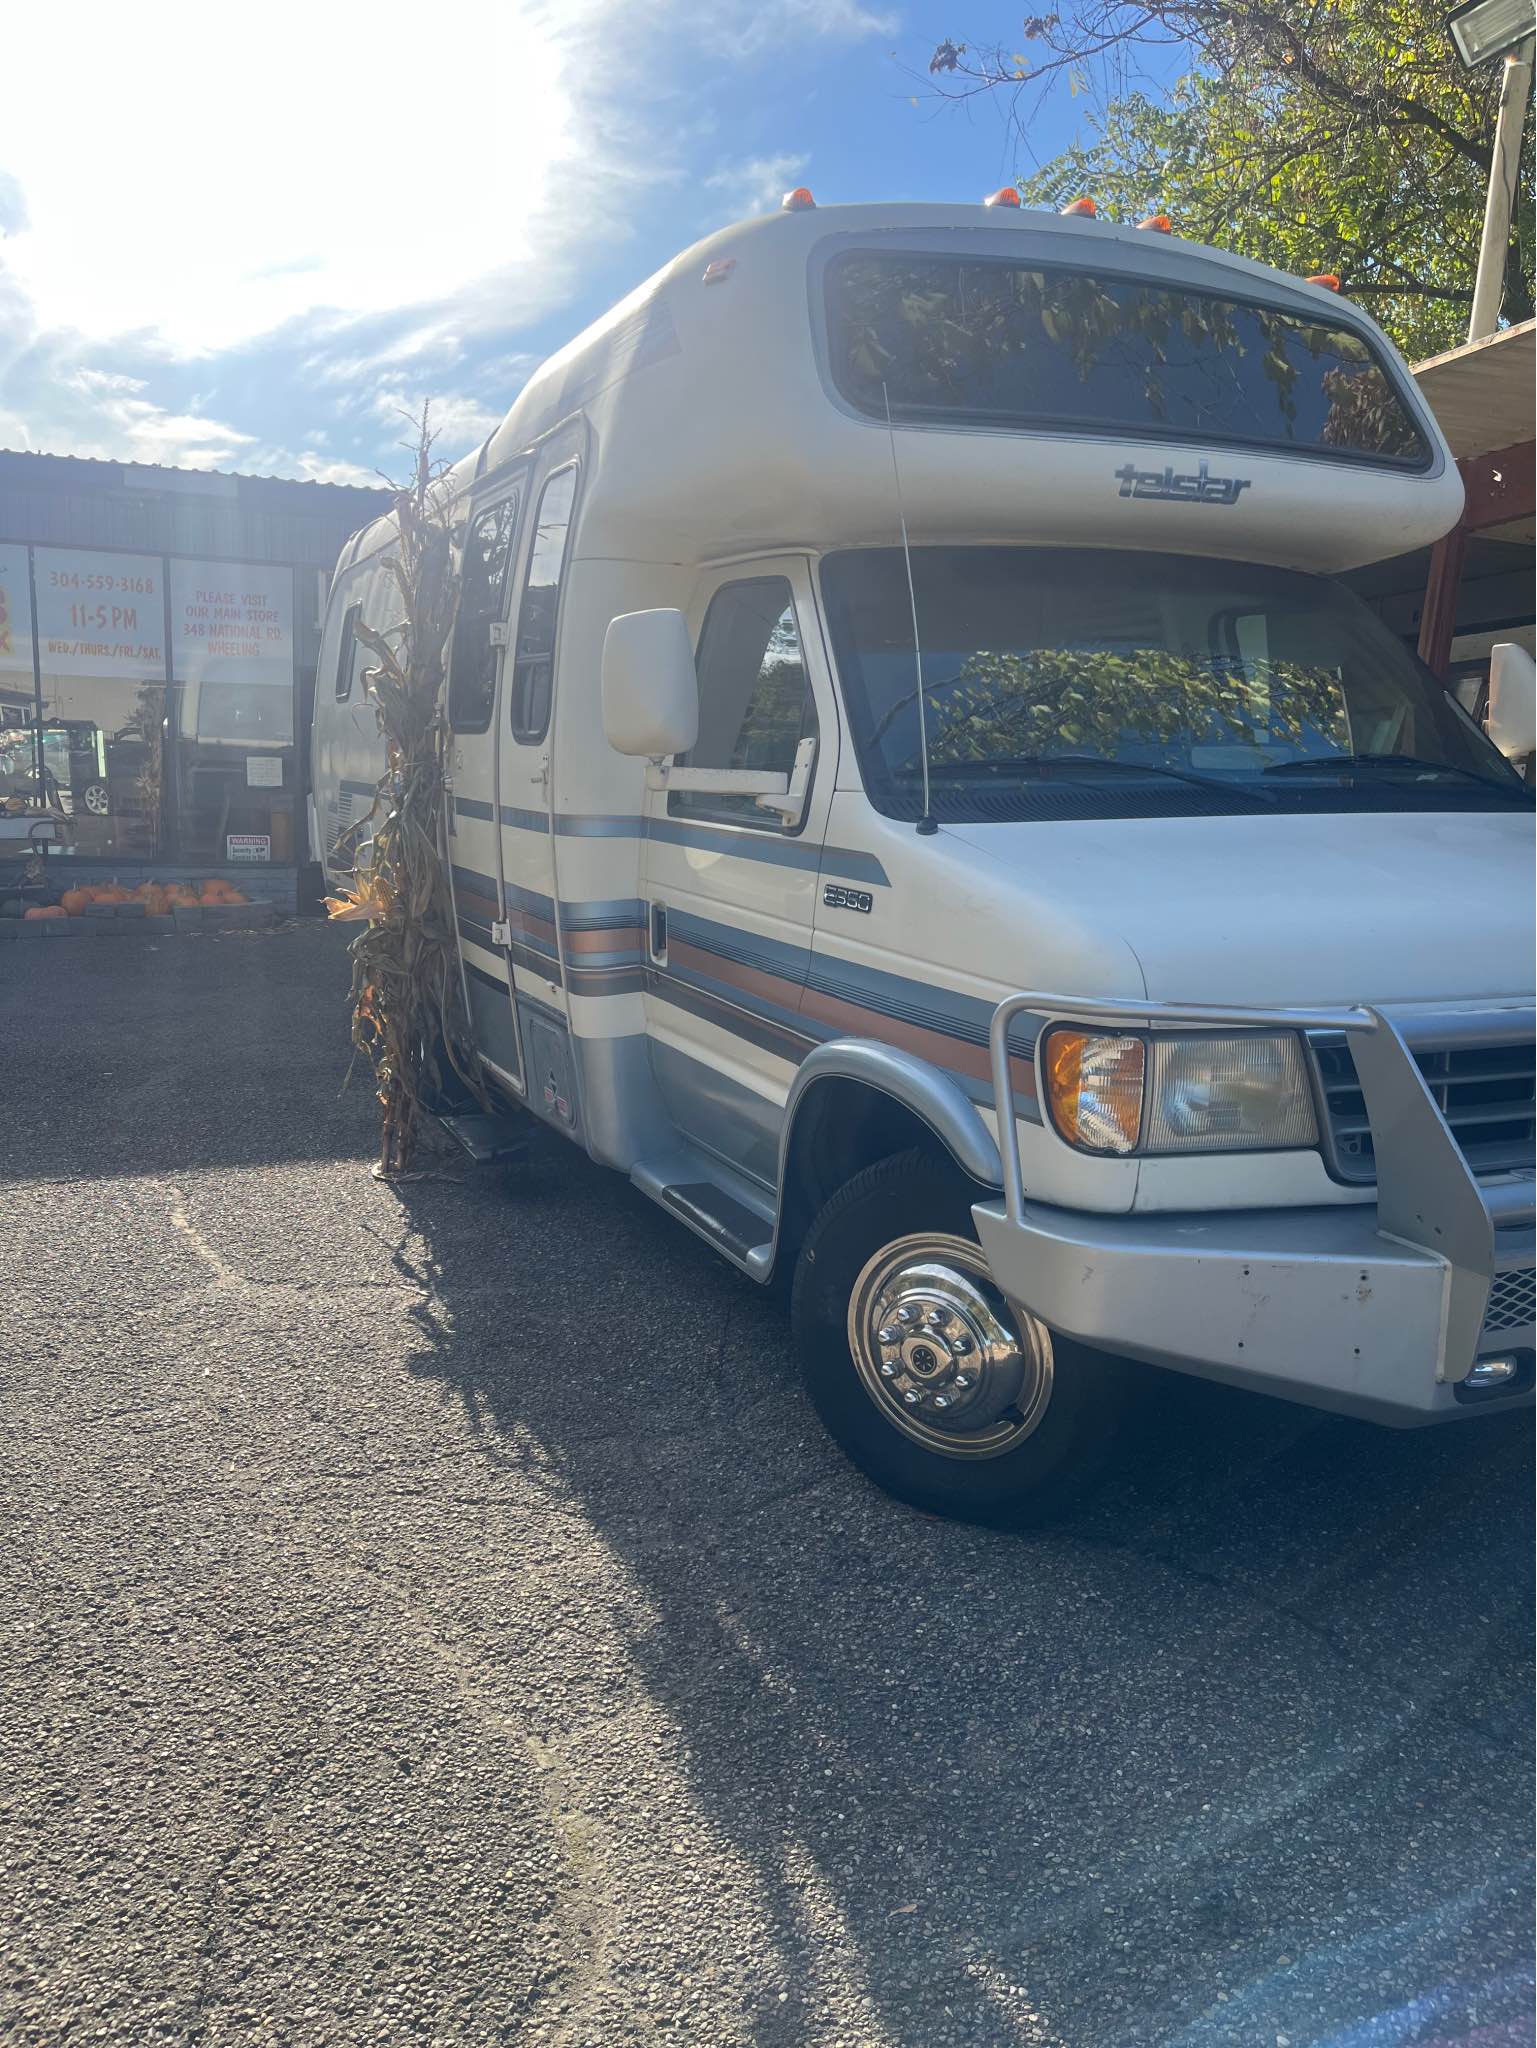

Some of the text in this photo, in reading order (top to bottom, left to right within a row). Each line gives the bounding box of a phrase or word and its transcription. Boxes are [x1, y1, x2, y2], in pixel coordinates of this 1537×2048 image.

[49, 571, 154, 594] 304-559-3168
[196, 590, 267, 607] PLEASE VISIT
[70, 603, 138, 631] 11-5 PM
[185, 605, 279, 622] OUR MAIN STORE
[183, 623, 283, 641] 348 NATIONAL RD.
[207, 641, 261, 657] WHEELING
[231, 837, 267, 846] WARNING
[824, 885, 871, 912] E350
